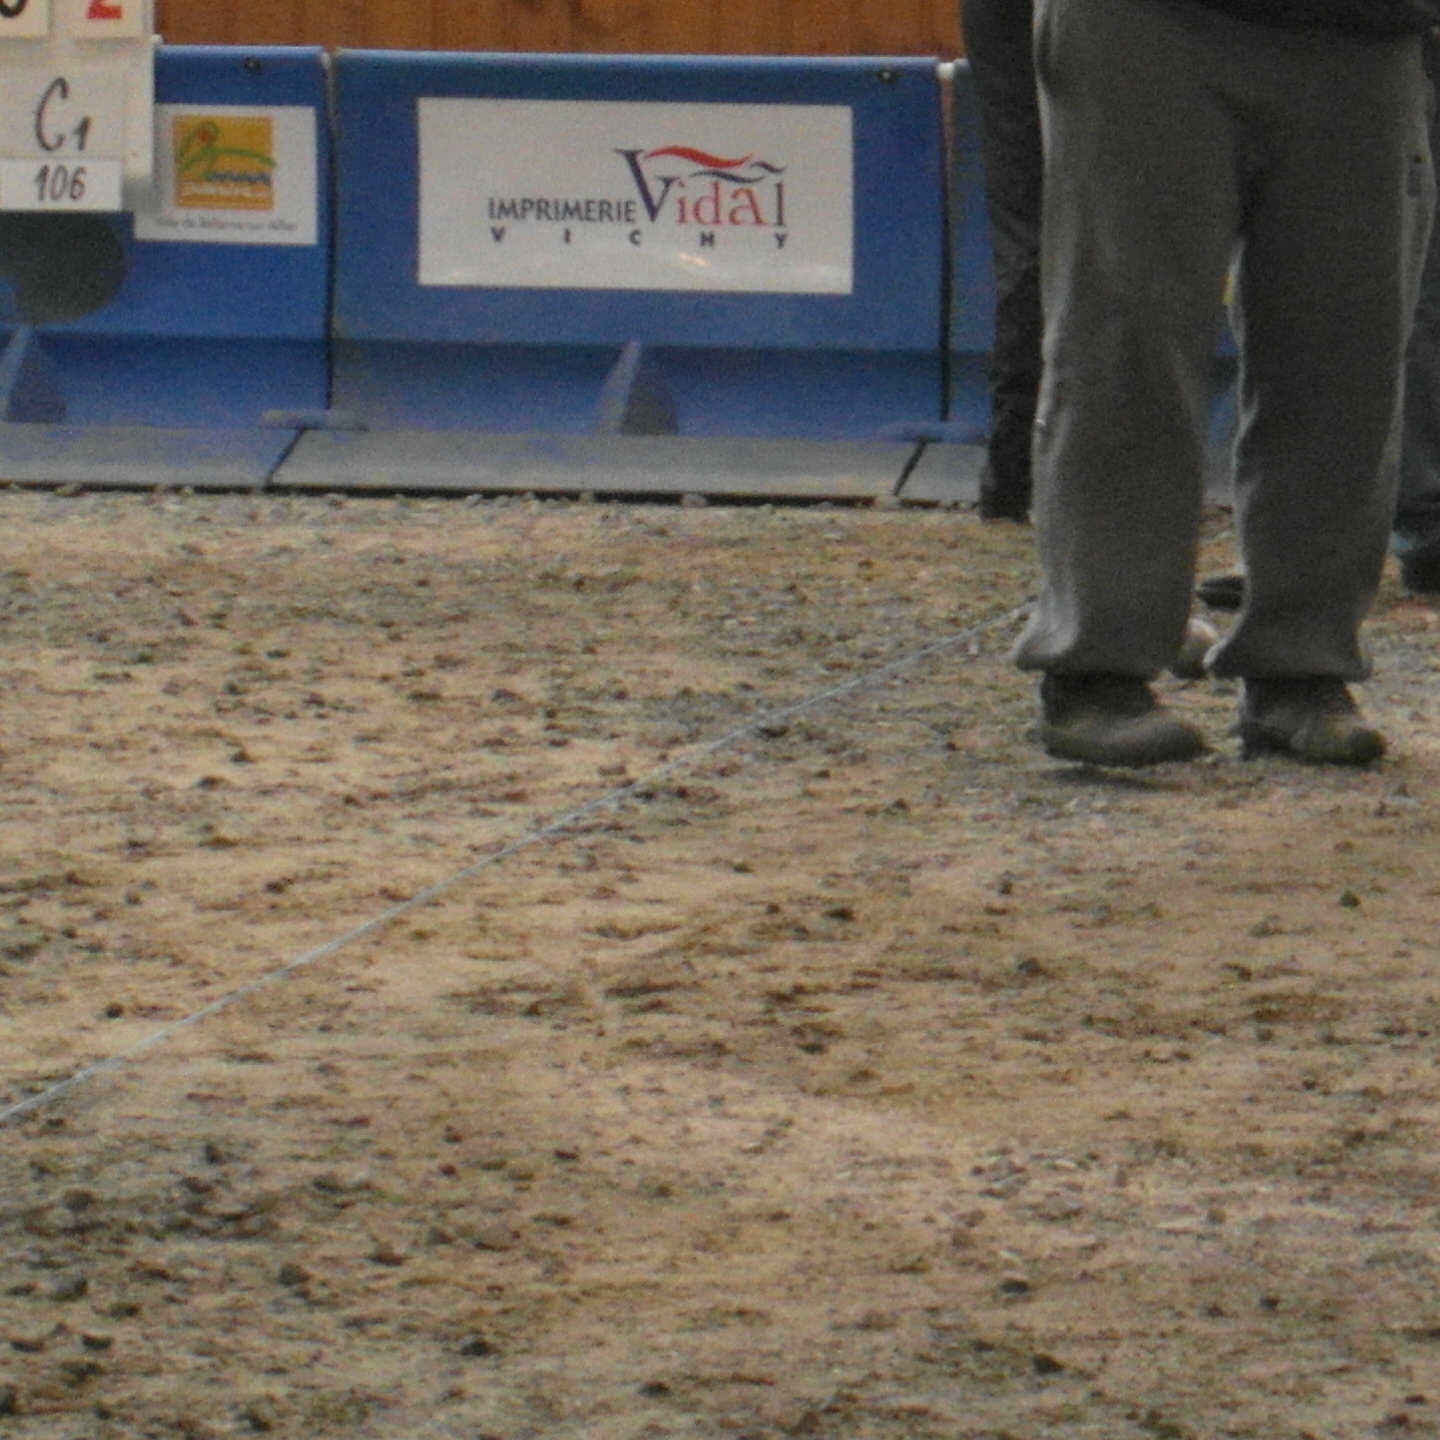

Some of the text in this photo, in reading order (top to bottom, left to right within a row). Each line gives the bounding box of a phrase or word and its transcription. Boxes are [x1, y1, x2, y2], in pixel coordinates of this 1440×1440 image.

[34, 163, 86, 202] 106
[488, 148, 789, 228] IMPRIMERIE Vidal
